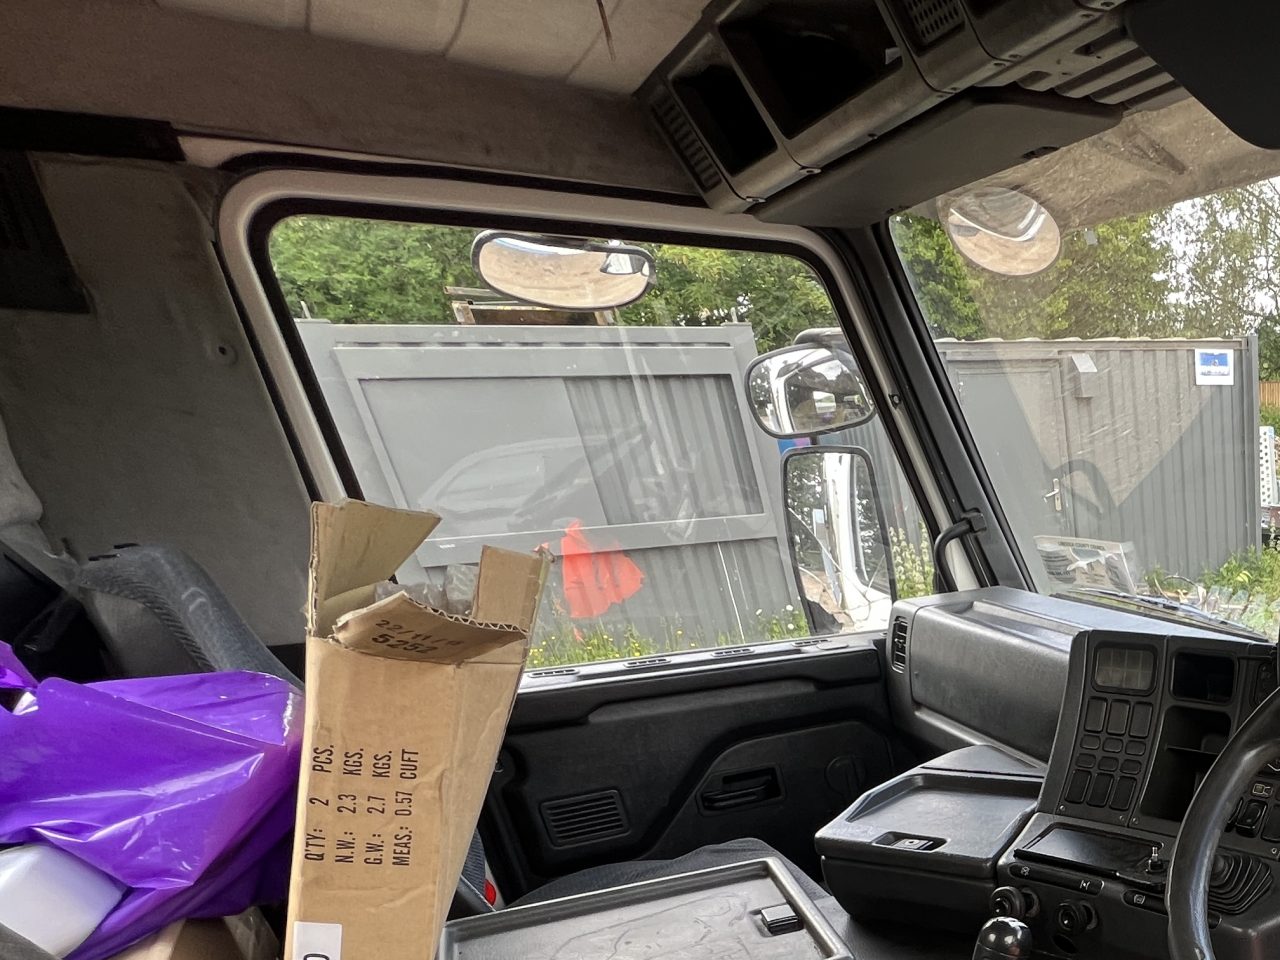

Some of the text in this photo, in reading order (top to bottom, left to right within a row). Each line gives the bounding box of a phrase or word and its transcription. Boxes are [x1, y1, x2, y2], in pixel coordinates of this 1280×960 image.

[372, 633, 438, 654] 5252
[304, 745, 334, 861] Q'TY: 2 PCS.
[335, 748, 364, 863] N.W.: 2.3 KGS.
[364, 750, 392, 865] G.W.: 2.7 KGS.
[392, 749, 419, 866] MEAS.: 0.57 CUFT
